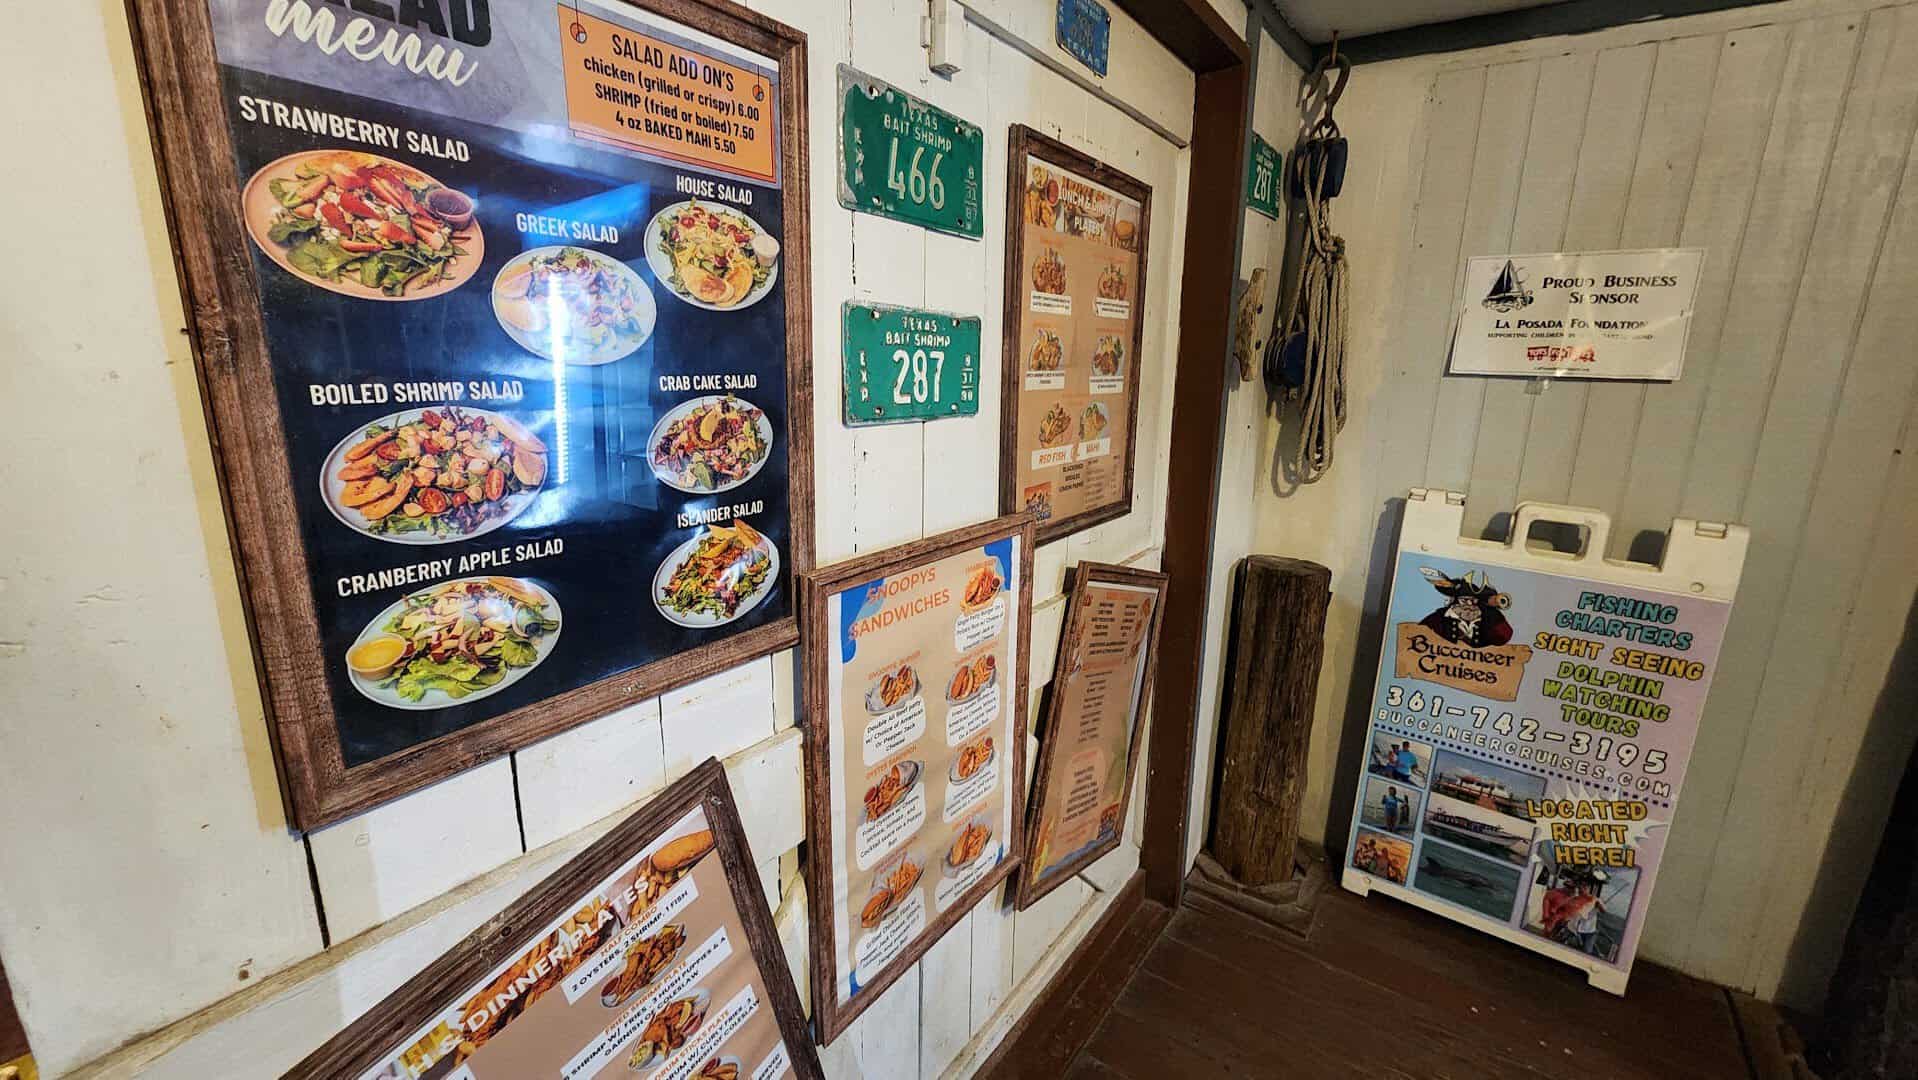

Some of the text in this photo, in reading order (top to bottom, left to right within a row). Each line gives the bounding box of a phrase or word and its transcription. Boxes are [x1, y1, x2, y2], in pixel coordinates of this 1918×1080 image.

[265, 0, 479, 87] menu
[612, 34, 734, 92] SALAD ADD ON'S
[584, 57, 759, 121] chicken (grilled or crispy) 6.00
[238, 95, 470, 163] STRAWBERRY SALAD
[595, 83, 754, 141] SHRIMP (fried or boiled) 7.50
[901, 101, 938, 130] TEXAS
[616, 111, 736, 155] 4 oz BAKED MAHI 5.50
[884, 114, 951, 152] BAIT SHRIMP
[676, 175, 753, 205] HOUSE SALAD
[888, 137, 945, 210] 466
[1254, 164, 1272, 204] 287
[516, 213, 619, 244] GREEK SALAD
[1542, 275, 1678, 289] PROUD BUSINESS
[886, 331, 950, 347] BAIT SHRIMP
[902, 316, 937, 332] TEXAS
[1495, 318, 1649, 330] LA POSADA FONDATION
[310, 380, 524, 406] BOILED SHRIMP SALAD
[659, 374, 757, 391] CRAB CAKE SALAD
[859, 351, 869, 402] EXP
[892, 350, 945, 404] 287
[677, 500, 764, 528] ISLANDER SALAD
[337, 538, 564, 597] CRANBERRY APPLE SALAD
[867, 567, 936, 604] SNOOPYS
[850, 588, 950, 640] SANDWICHES
[1578, 591, 1678, 625] FISHING
[1555, 610, 1694, 652] CHARTERS
[1407, 634, 1517, 668] Buccaneer
[1534, 632, 1706, 681] SIGHT SEEING
[1418, 656, 1498, 685] Cruises
[1557, 661, 1664, 698] DOLPHIN
[1542, 679, 1671, 722] WATCHING
[867, 719, 887, 734] Double
[874, 727, 893, 740] Choice
[900, 709, 923, 724] American
[883, 731, 902, 744] Pepper
[904, 723, 915, 733] Jack
[1386, 686, 1668, 775] 361-742-3195
[1561, 704, 1640, 739] TOURS
[885, 739, 906, 752] Cheese
[1377, 709, 1672, 798] BUCCANEERCRUISES.COM
[1527, 799, 1648, 821] LOCATED
[860, 840, 881, 858] Cocktail
[1551, 823, 1628, 844] RIGHT
[1555, 846, 1635, 868] HERE!
[571, 982, 578, 993] 2
[623, 939, 630, 948] 2
[670, 889, 688, 908] FISH
[600, 904, 658, 957] HALF COMBO
[467, 876, 650, 1033] DINNER PLATES
[570, 1041, 607, 1075] SHRIMP
[607, 1027, 621, 1043] W/
[659, 976, 682, 999] HUSH
[681, 948, 712, 979] PUPPIES
[603, 1010, 630, 1036] FRIED
[630, 984, 661, 1013] SHRIMP
[604, 970, 700, 1057] GARNISH OF COLESLAW
[688, 1047, 699, 1061] W/
[699, 1025, 725, 1051] CURLY
[713, 1036, 724, 1048] OF
